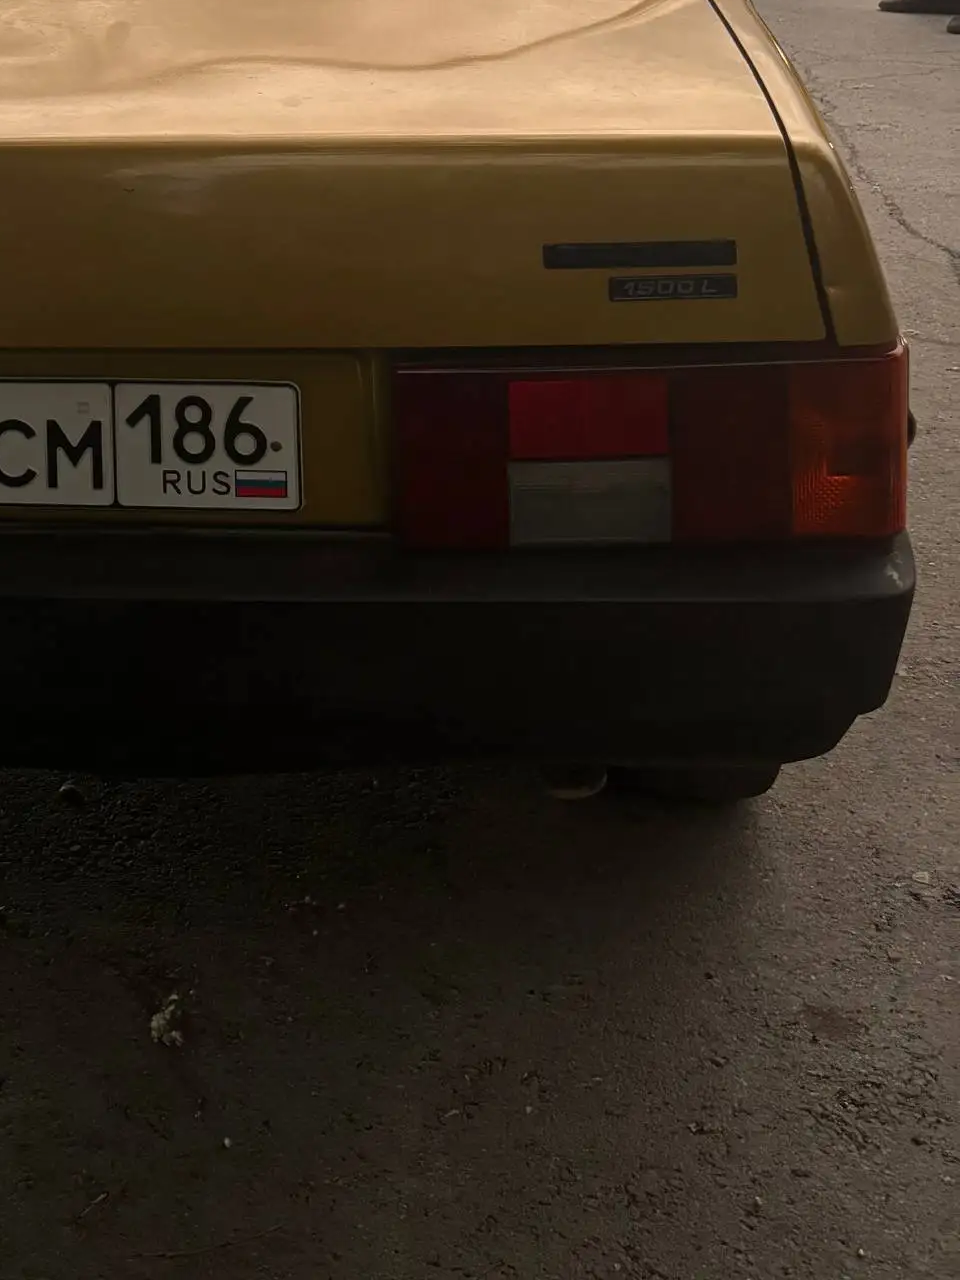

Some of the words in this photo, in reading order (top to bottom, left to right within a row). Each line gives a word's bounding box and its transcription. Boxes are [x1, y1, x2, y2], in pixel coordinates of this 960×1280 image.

[623, 280, 693, 296] 1500
[125, 394, 269, 466] 186
[162, 470, 232, 495] RUS
